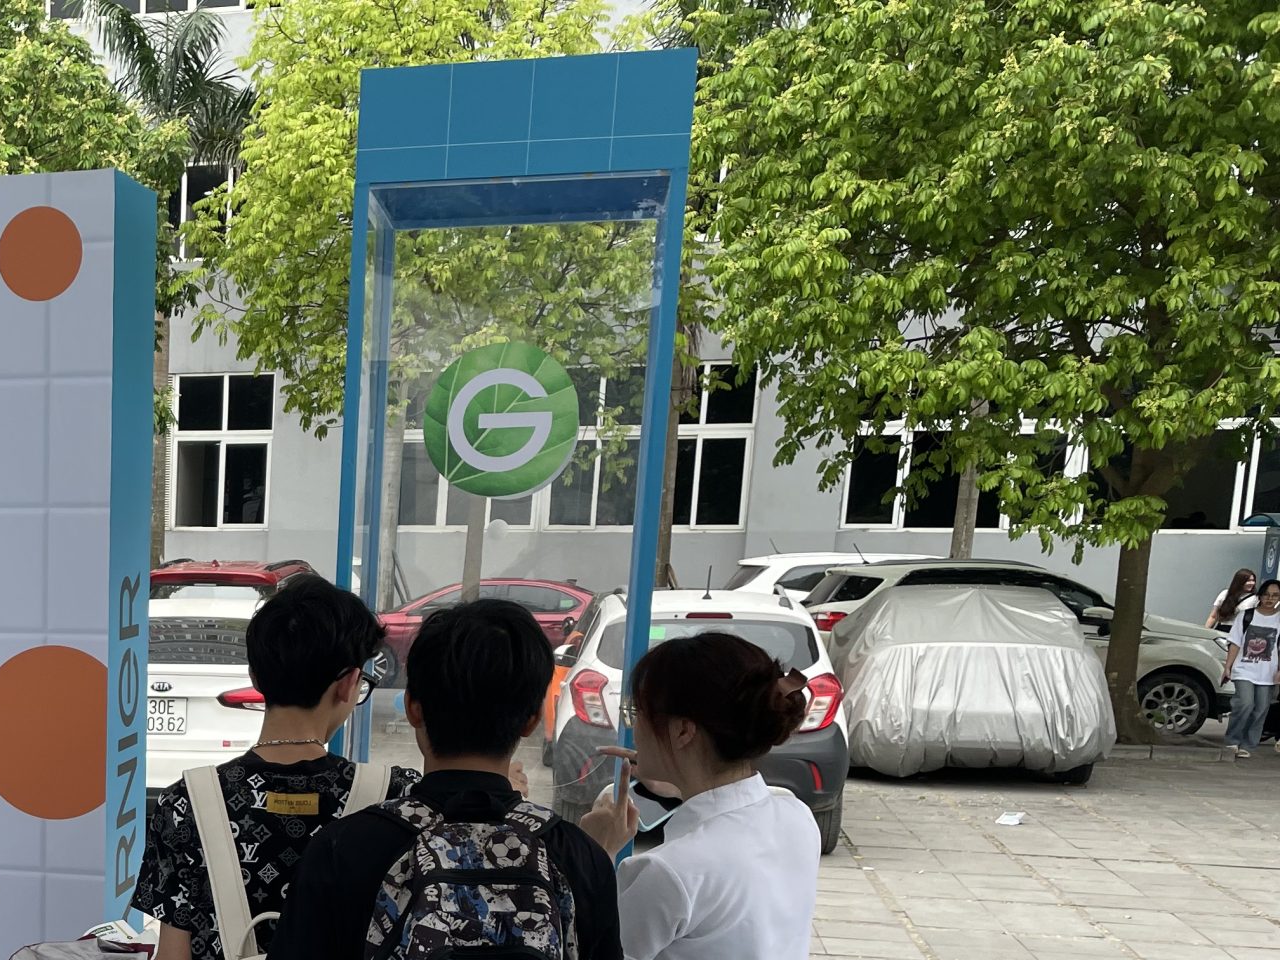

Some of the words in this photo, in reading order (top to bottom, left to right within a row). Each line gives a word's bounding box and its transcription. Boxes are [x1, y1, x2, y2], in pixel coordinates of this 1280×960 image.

[448, 368, 552, 472] G
[153, 682, 170, 692] KIA
[149, 700, 175, 715] 30E
[147, 717, 185, 732] 03.62
